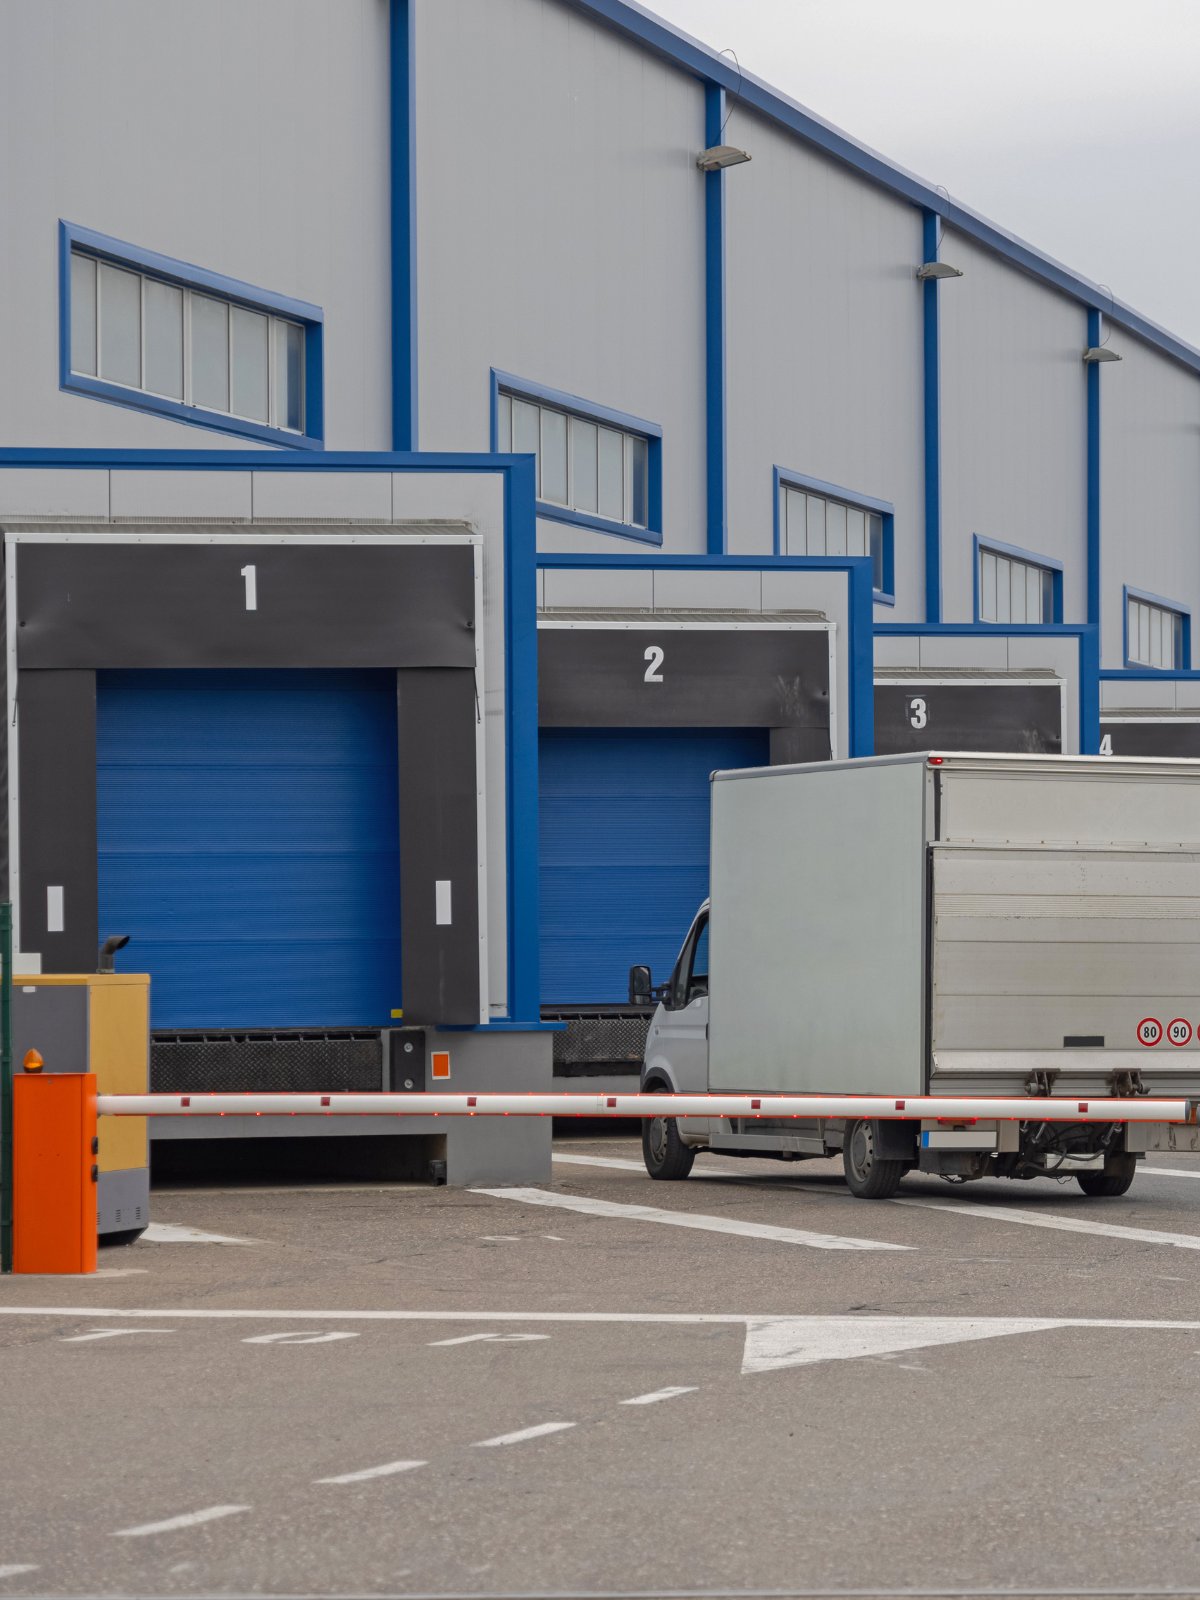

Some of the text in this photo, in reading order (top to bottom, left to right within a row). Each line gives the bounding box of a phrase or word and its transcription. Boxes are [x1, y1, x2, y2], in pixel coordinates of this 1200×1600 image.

[240, 565, 257, 611] 1
[643, 645, 665, 683] 2
[909, 698, 928, 730] 3
[1099, 734, 1113, 756] 4
[1143, 1026, 1157, 1039] 80
[1173, 1026, 1187, 1039] 90
